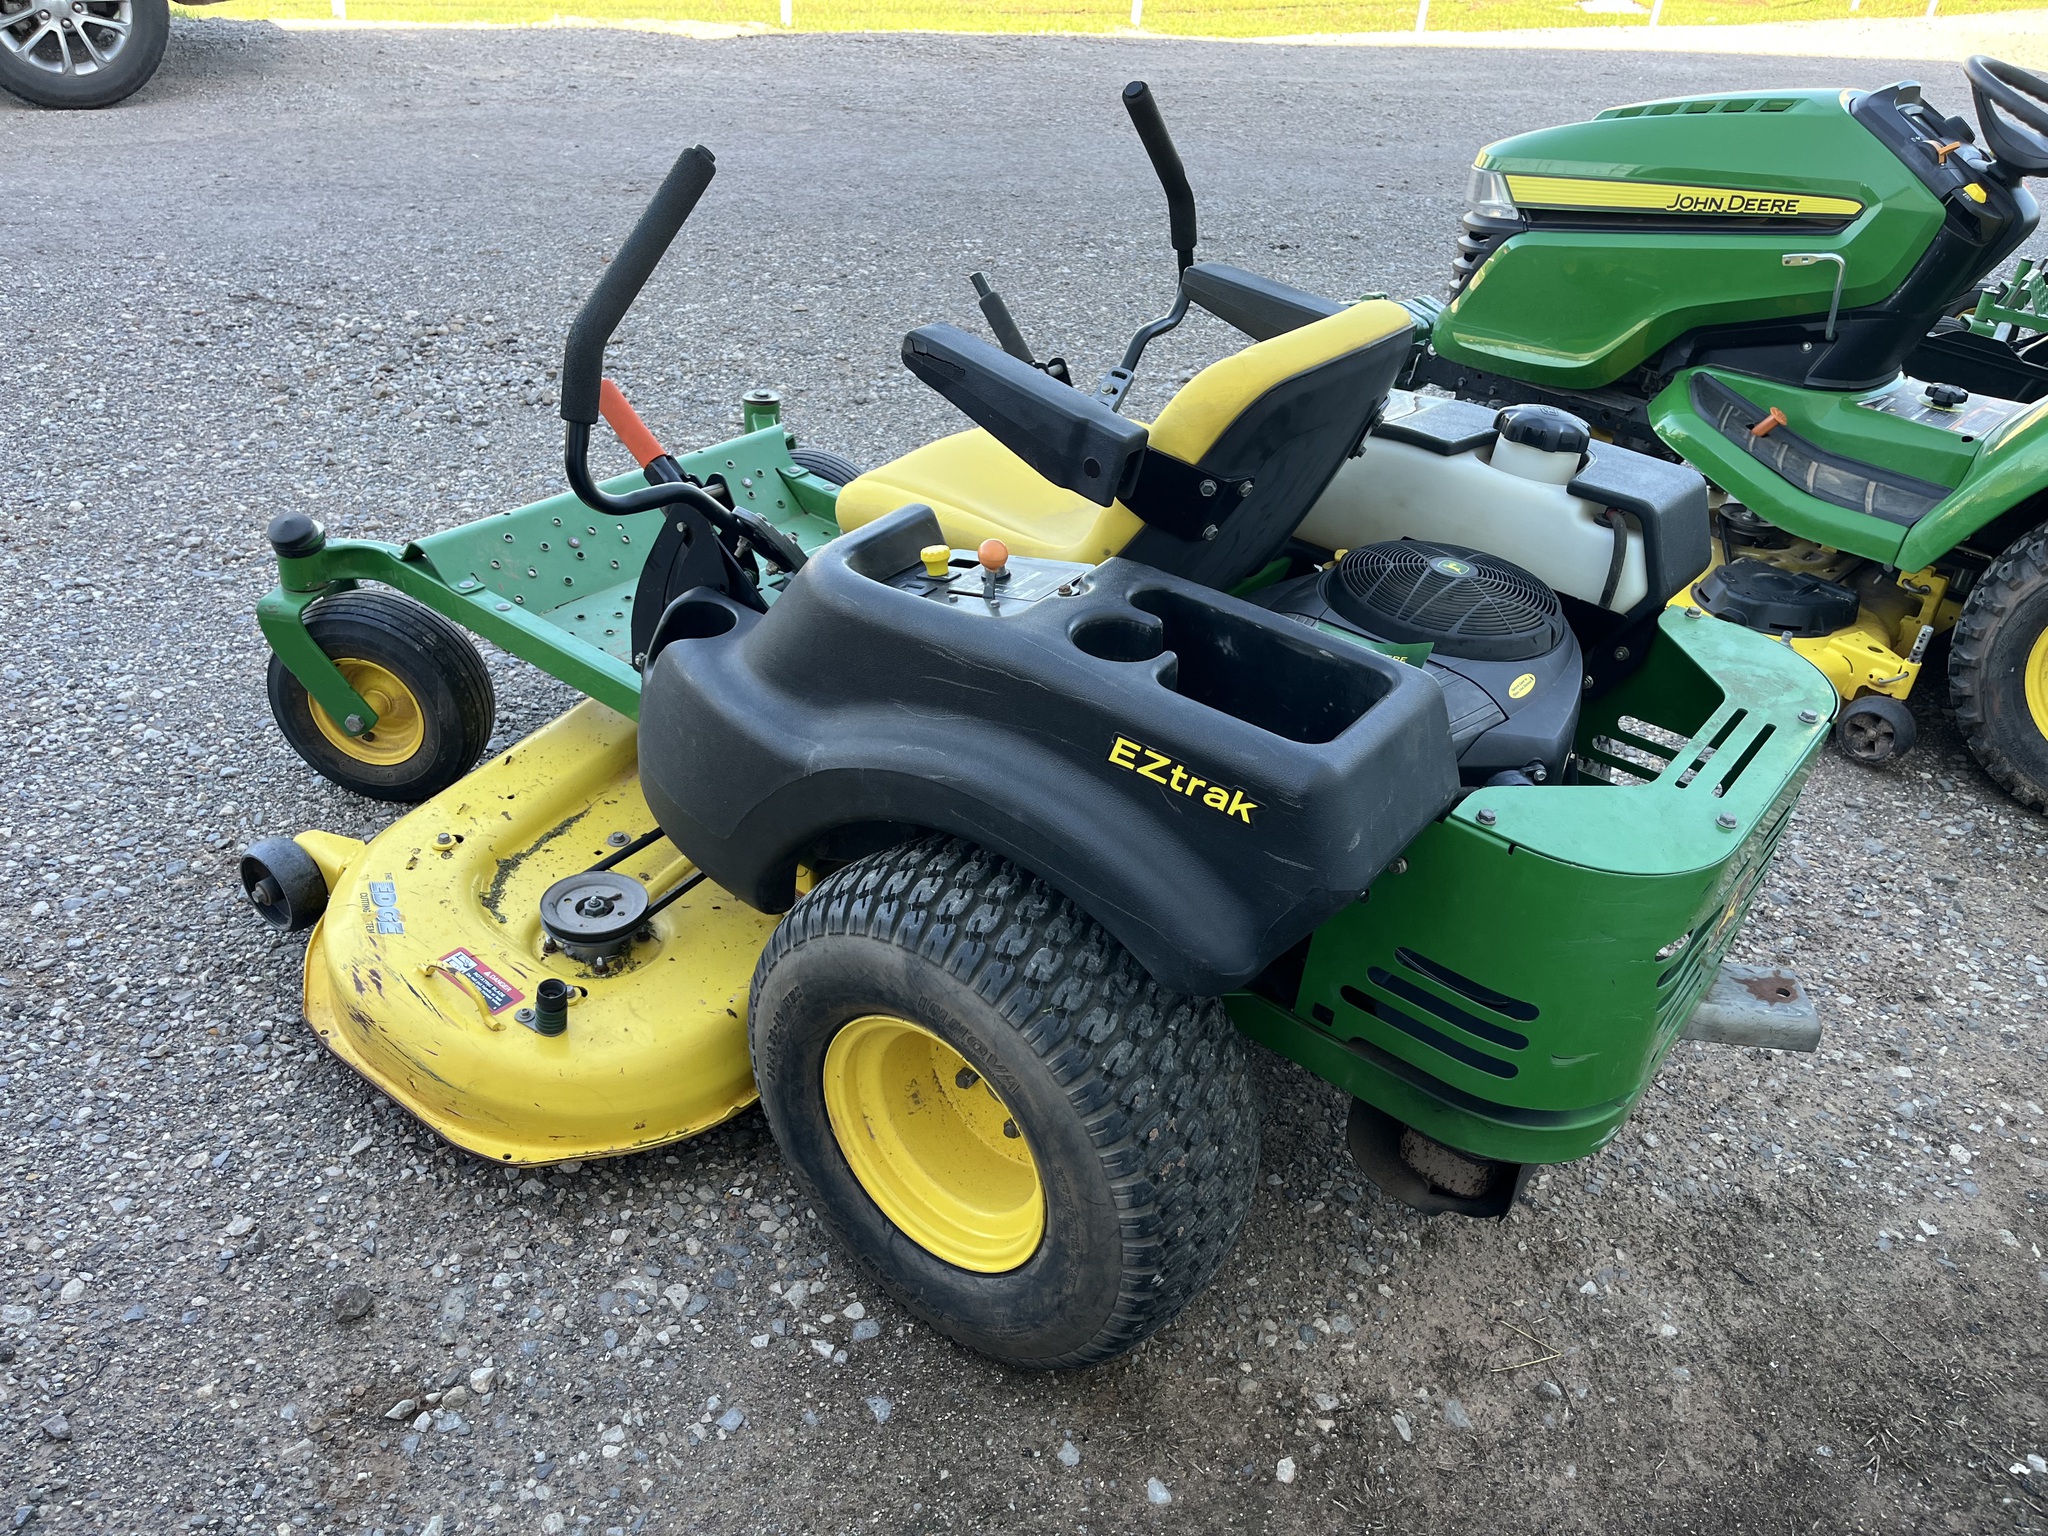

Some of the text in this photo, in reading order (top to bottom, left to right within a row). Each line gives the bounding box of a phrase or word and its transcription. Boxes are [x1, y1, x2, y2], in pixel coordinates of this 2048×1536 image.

[1667, 193, 1800, 213] JOHN DEERE
[1108, 736, 1258, 824] EZtrak
[360, 892, 371, 913] CUTTING
[369, 881, 405, 935] EDGE
[473, 971, 506, 998] ROTATING BLADE
[489, 974, 512, 992] DANGER
